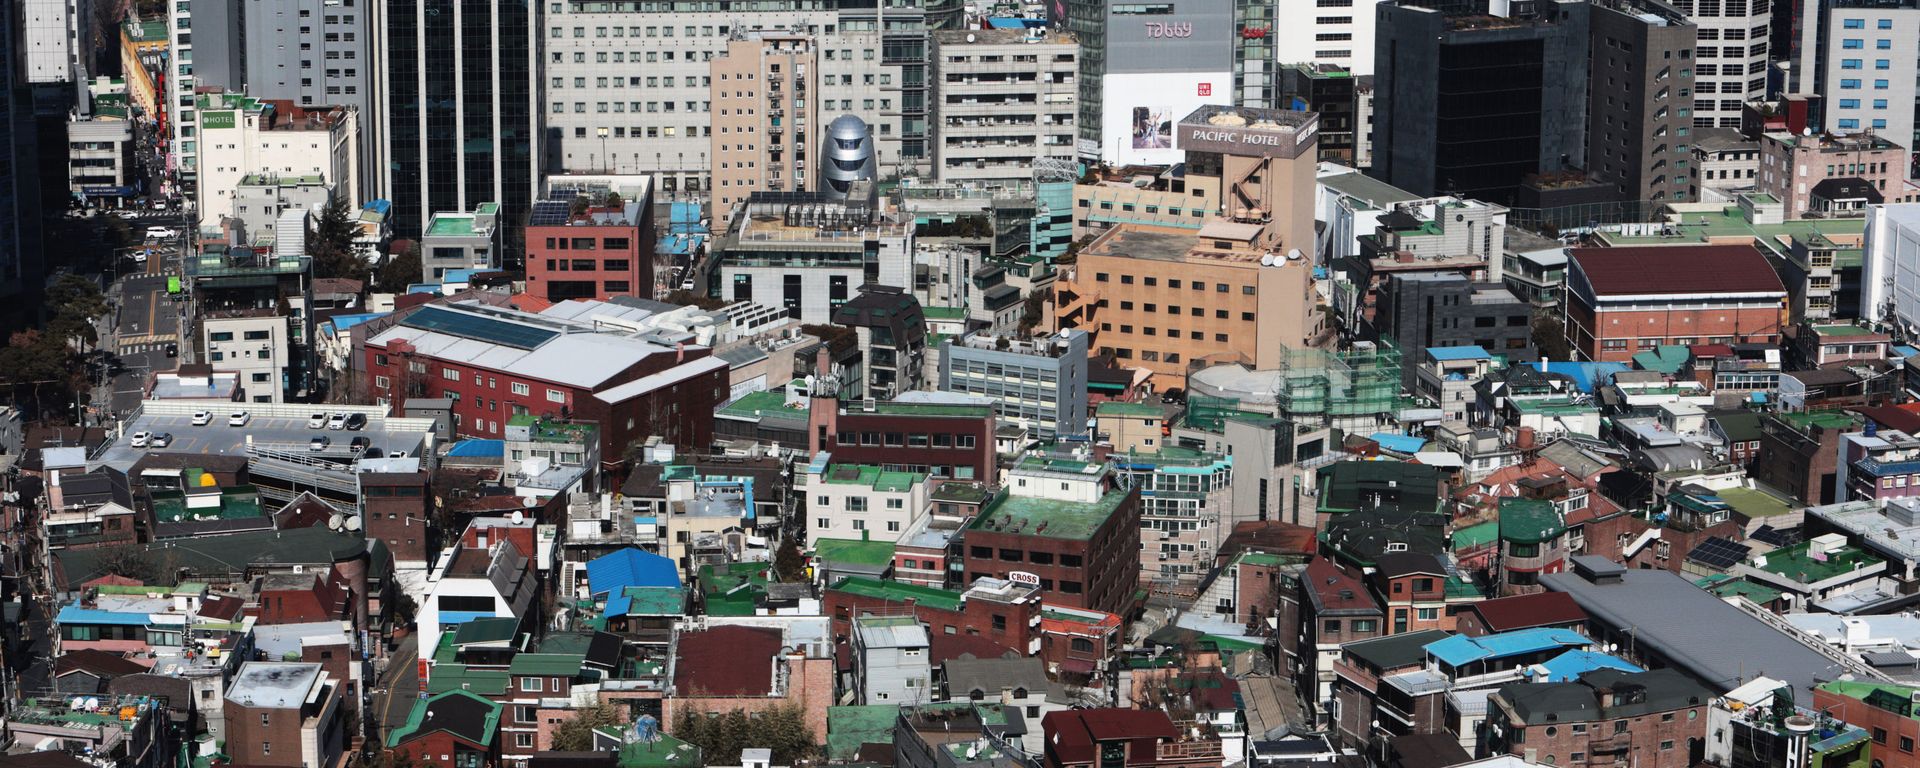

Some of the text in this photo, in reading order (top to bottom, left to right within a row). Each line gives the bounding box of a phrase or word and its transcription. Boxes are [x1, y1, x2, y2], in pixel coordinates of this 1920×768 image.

[1192, 129, 1279, 146] PACIFIC HOTEL
[1011, 573, 1037, 583] CROSS
